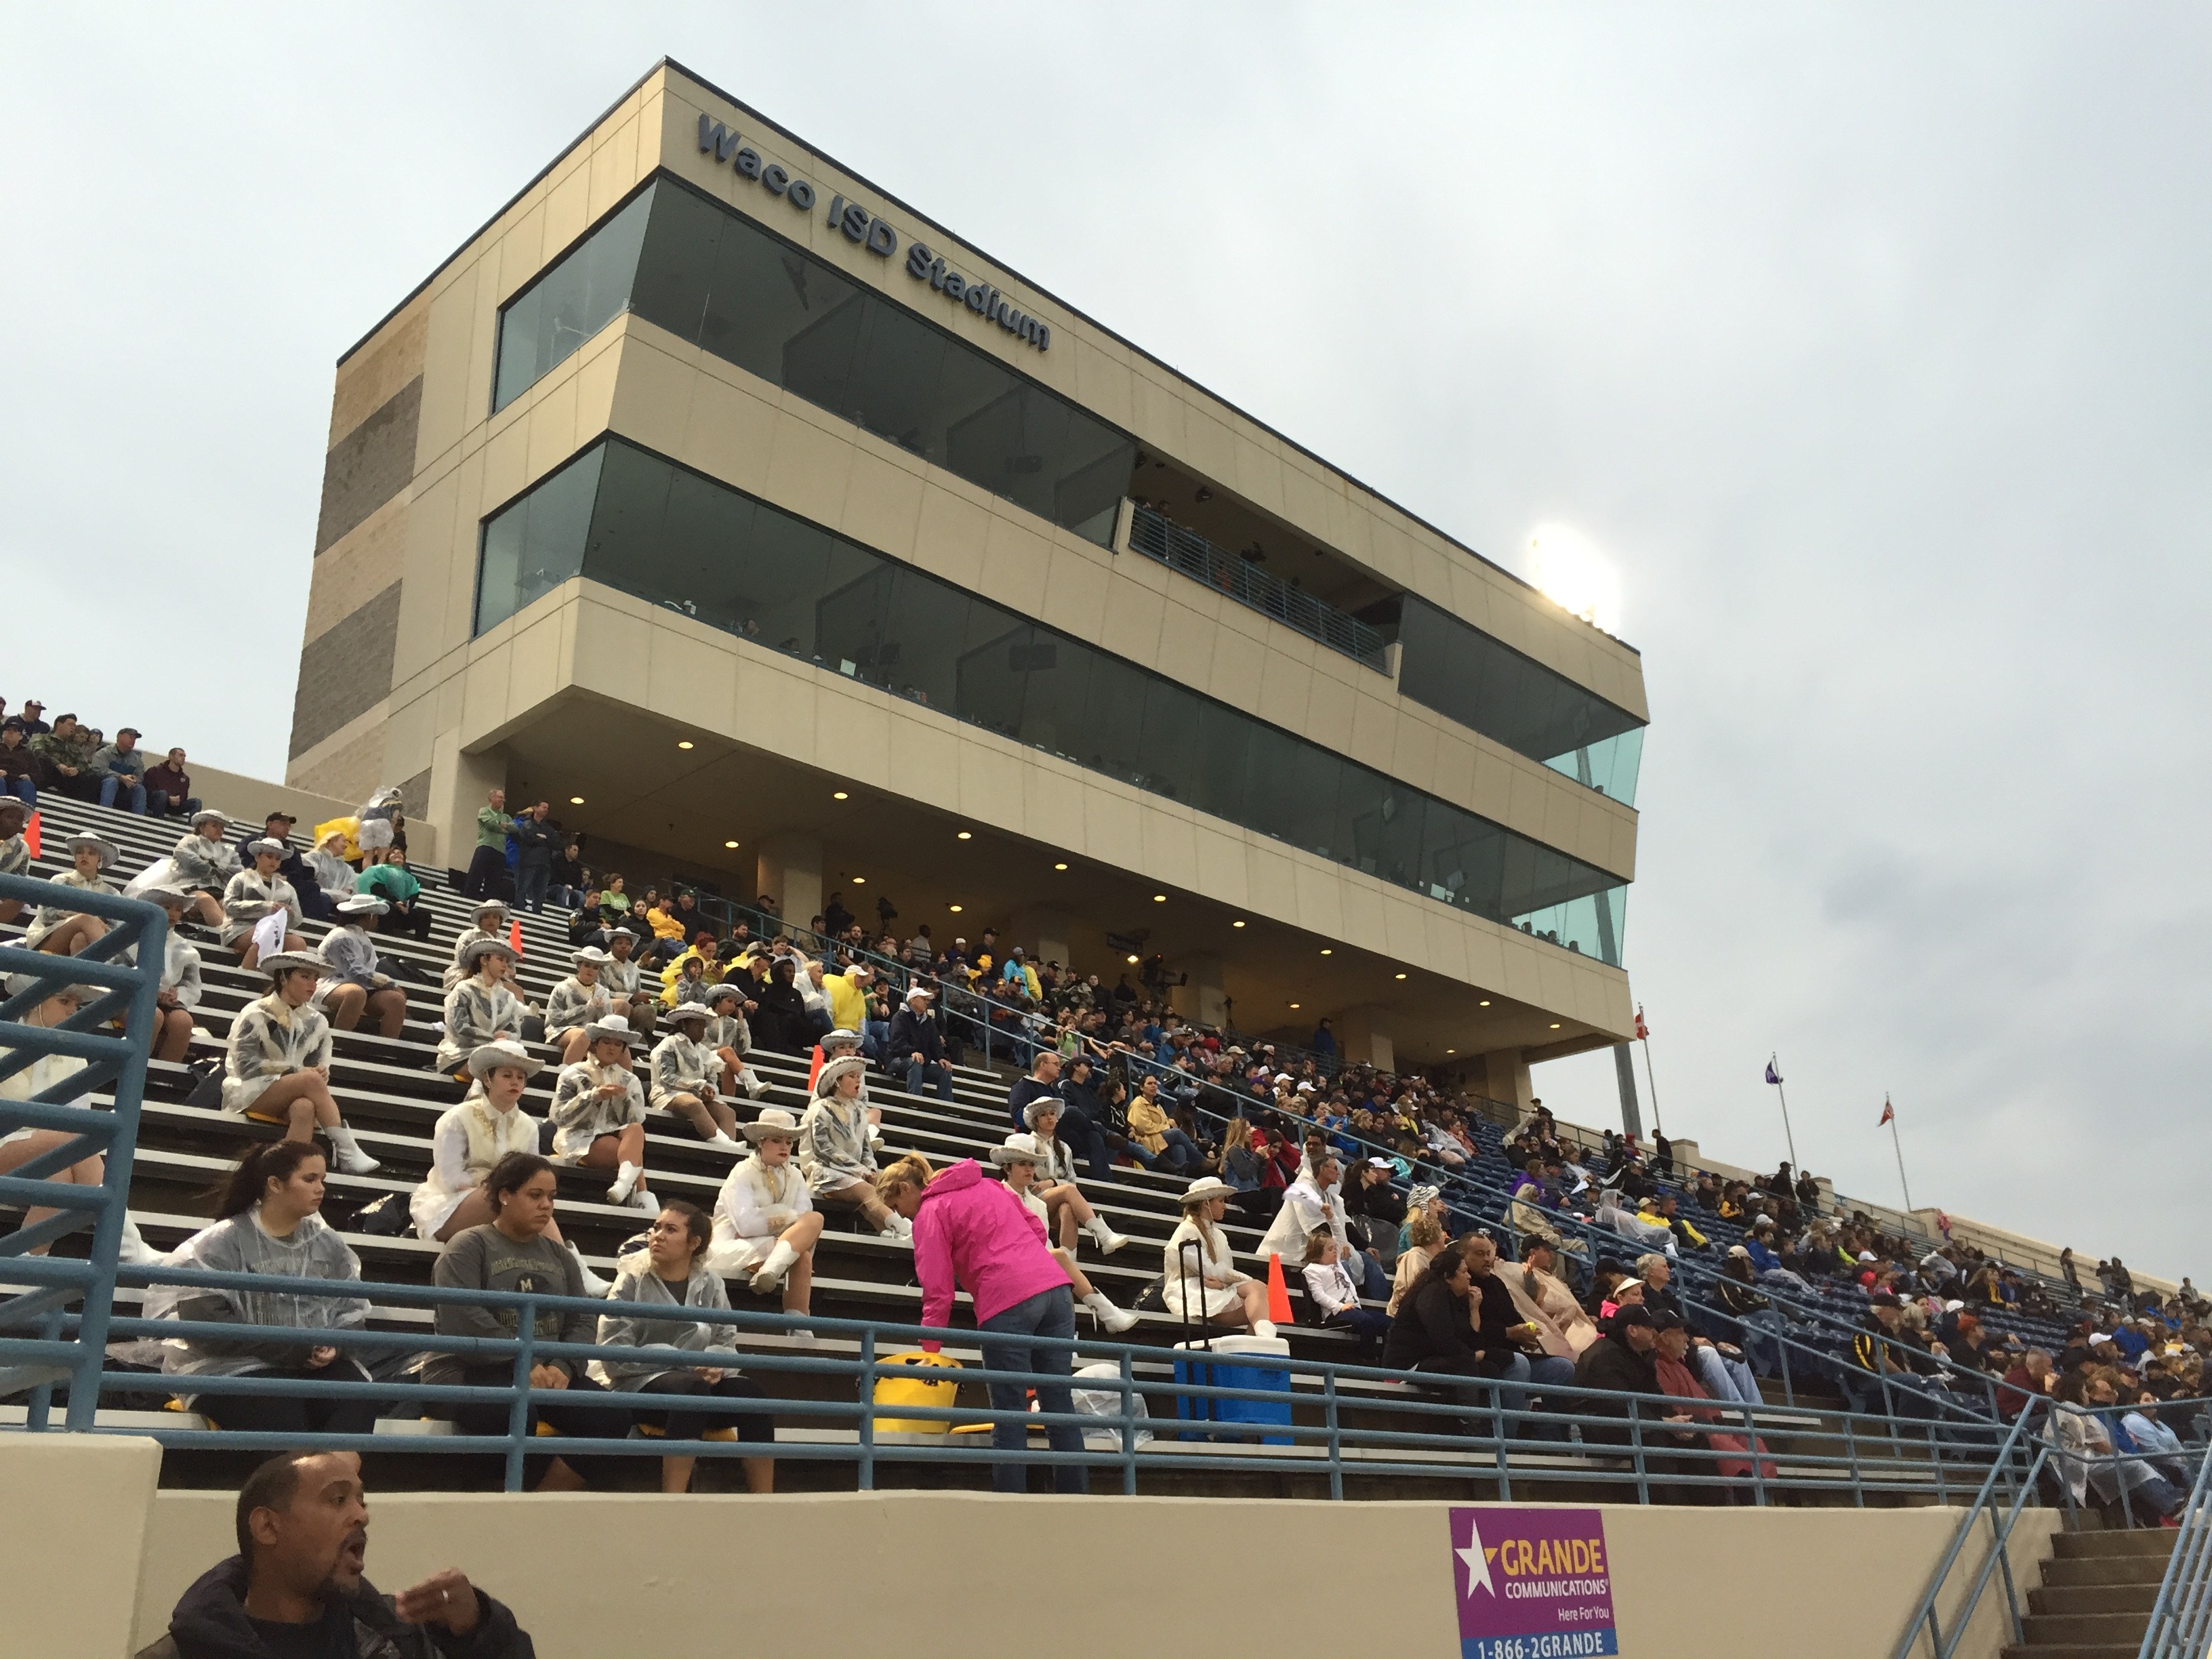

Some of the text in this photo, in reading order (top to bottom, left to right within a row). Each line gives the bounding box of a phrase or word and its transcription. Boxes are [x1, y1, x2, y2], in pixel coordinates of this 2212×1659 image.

[698, 113, 1051, 352] Waco ISD Stadium
[1500, 1539, 1605, 1576] GRANDE
[1558, 1605, 1610, 1622] Here For You
[1478, 1632, 1604, 1659] 1-866-2GRANDE
